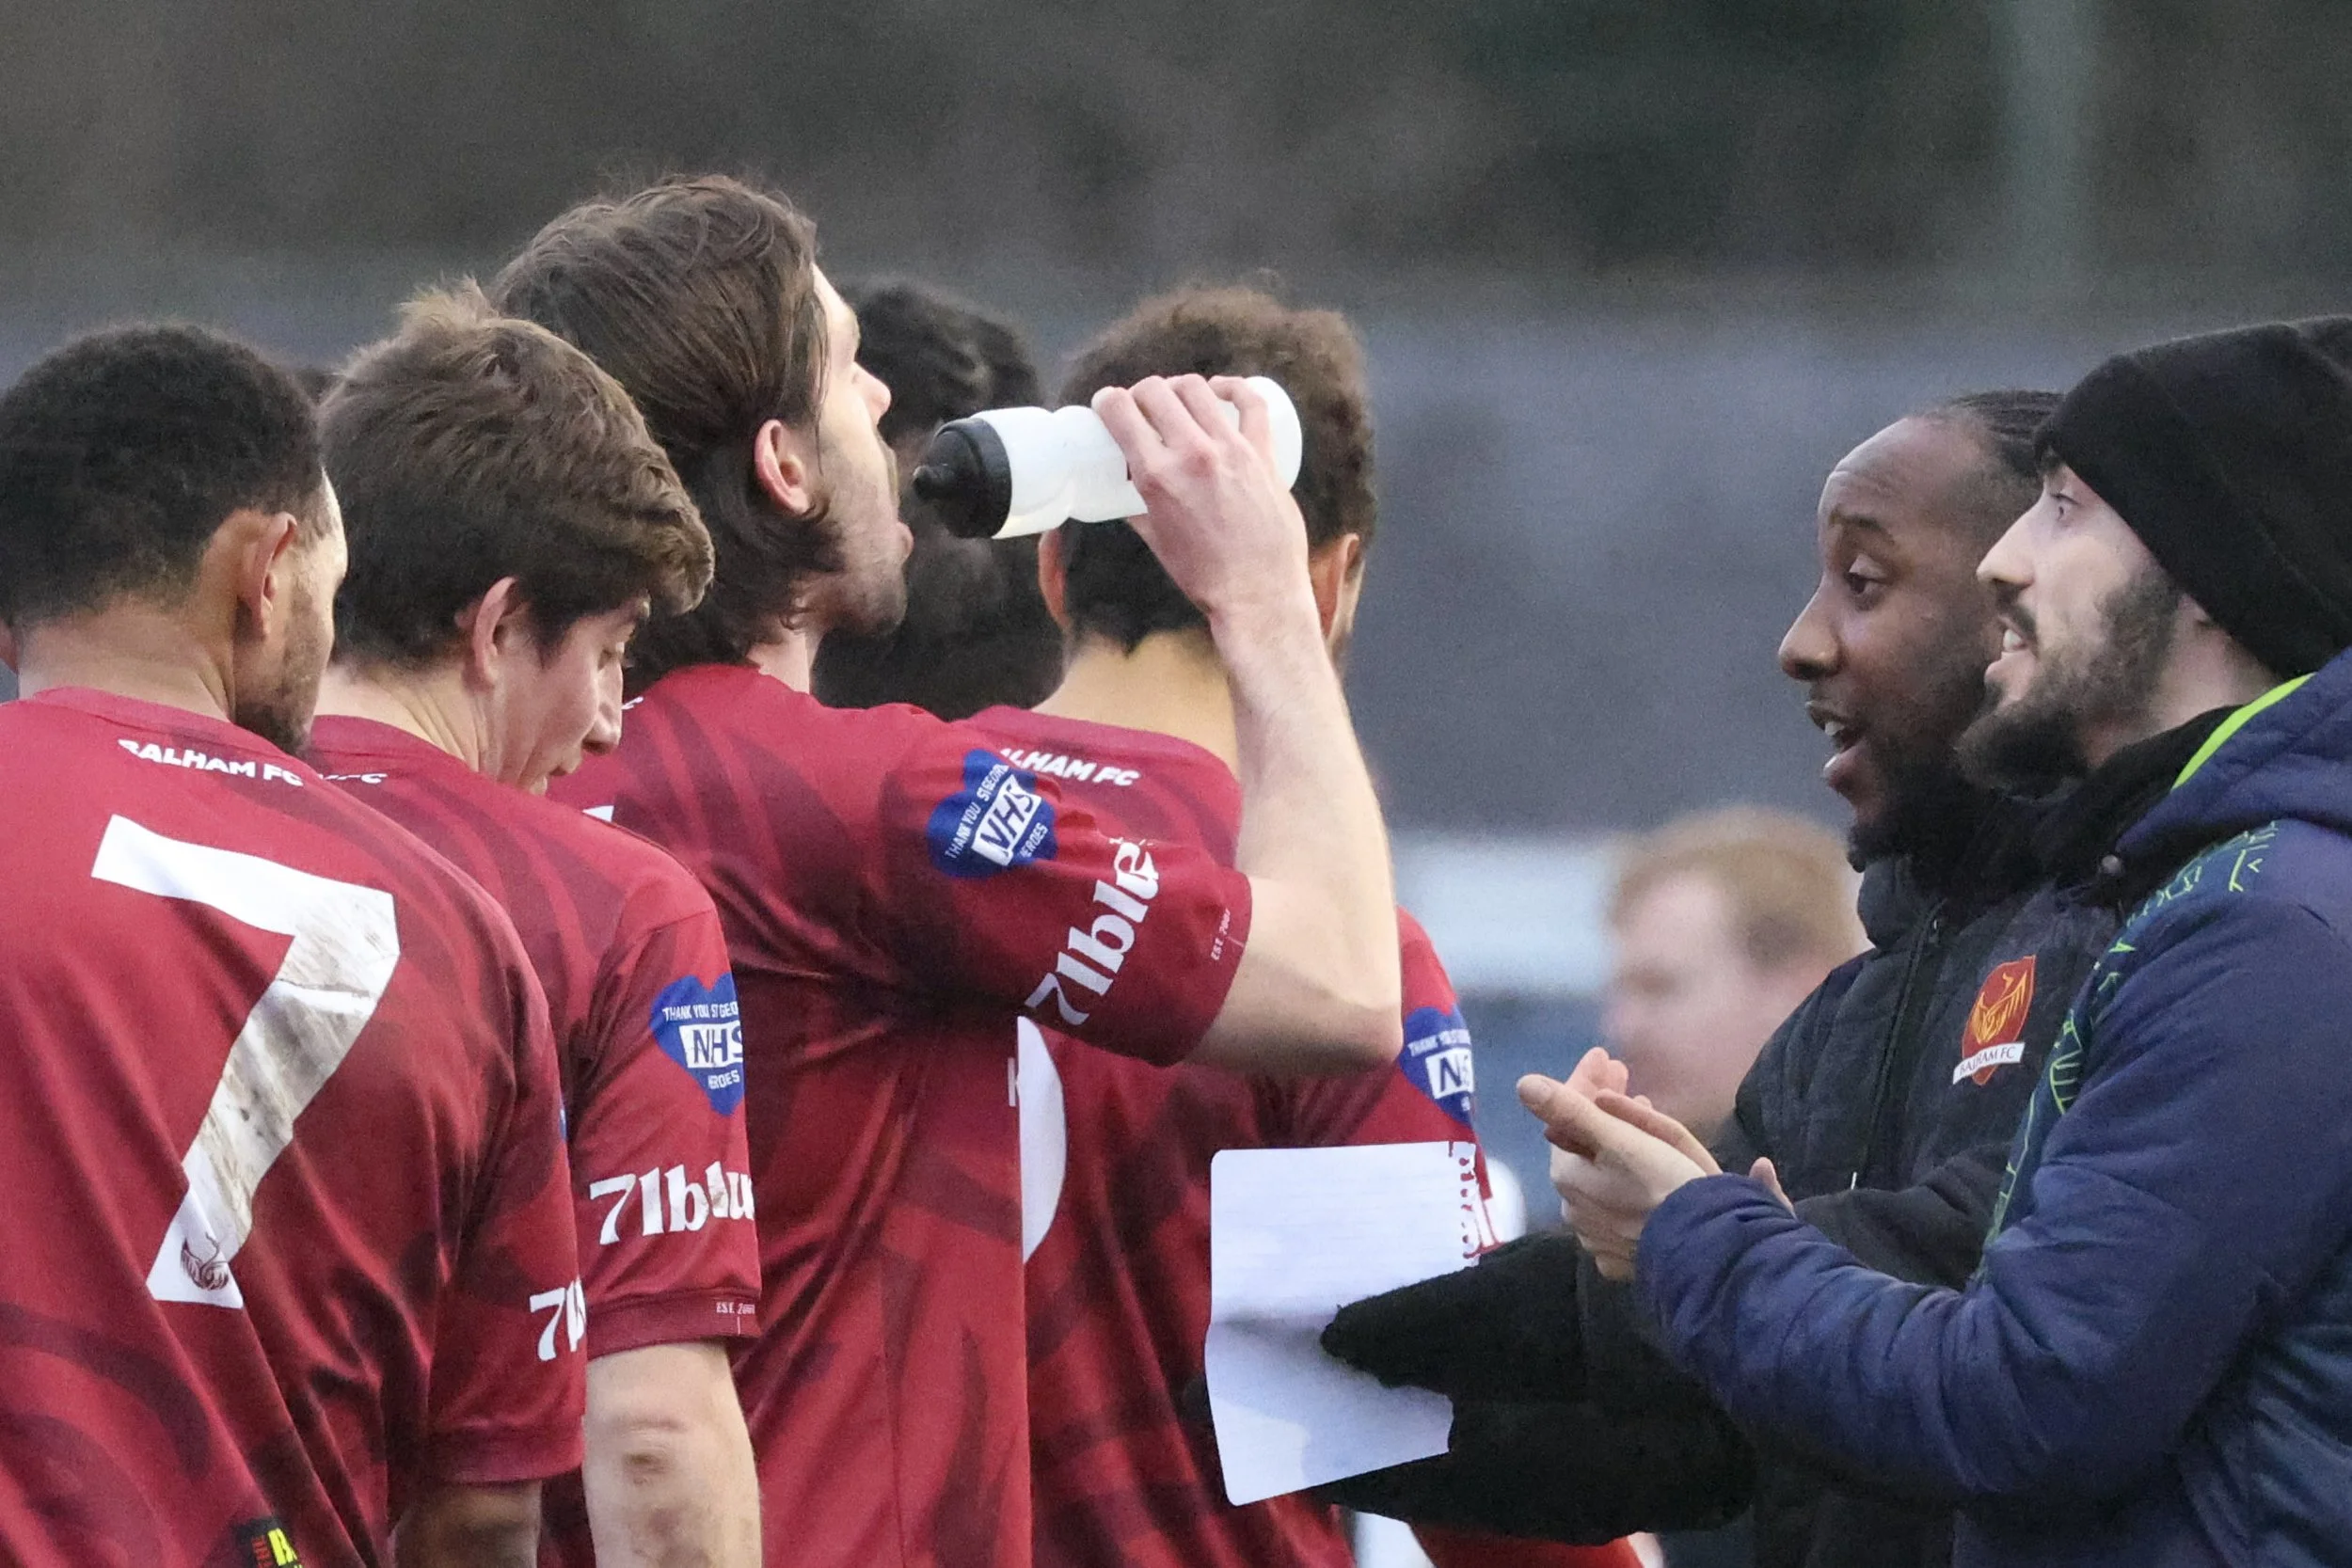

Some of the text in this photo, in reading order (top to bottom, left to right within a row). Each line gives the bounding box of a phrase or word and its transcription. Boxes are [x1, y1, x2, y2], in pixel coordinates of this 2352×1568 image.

[263, 763, 305, 786] FC
[1092, 766, 1141, 786] FC
[945, 821, 973, 859] THANK
[962, 801, 981, 825] YOU
[662, 1004, 691, 1022] THANK
[692, 1004, 709, 1019] YOU
[91, 815, 401, 1308] 7
[2000, 1046, 2016, 1059] FC
[589, 1160, 755, 1245] 71blu
